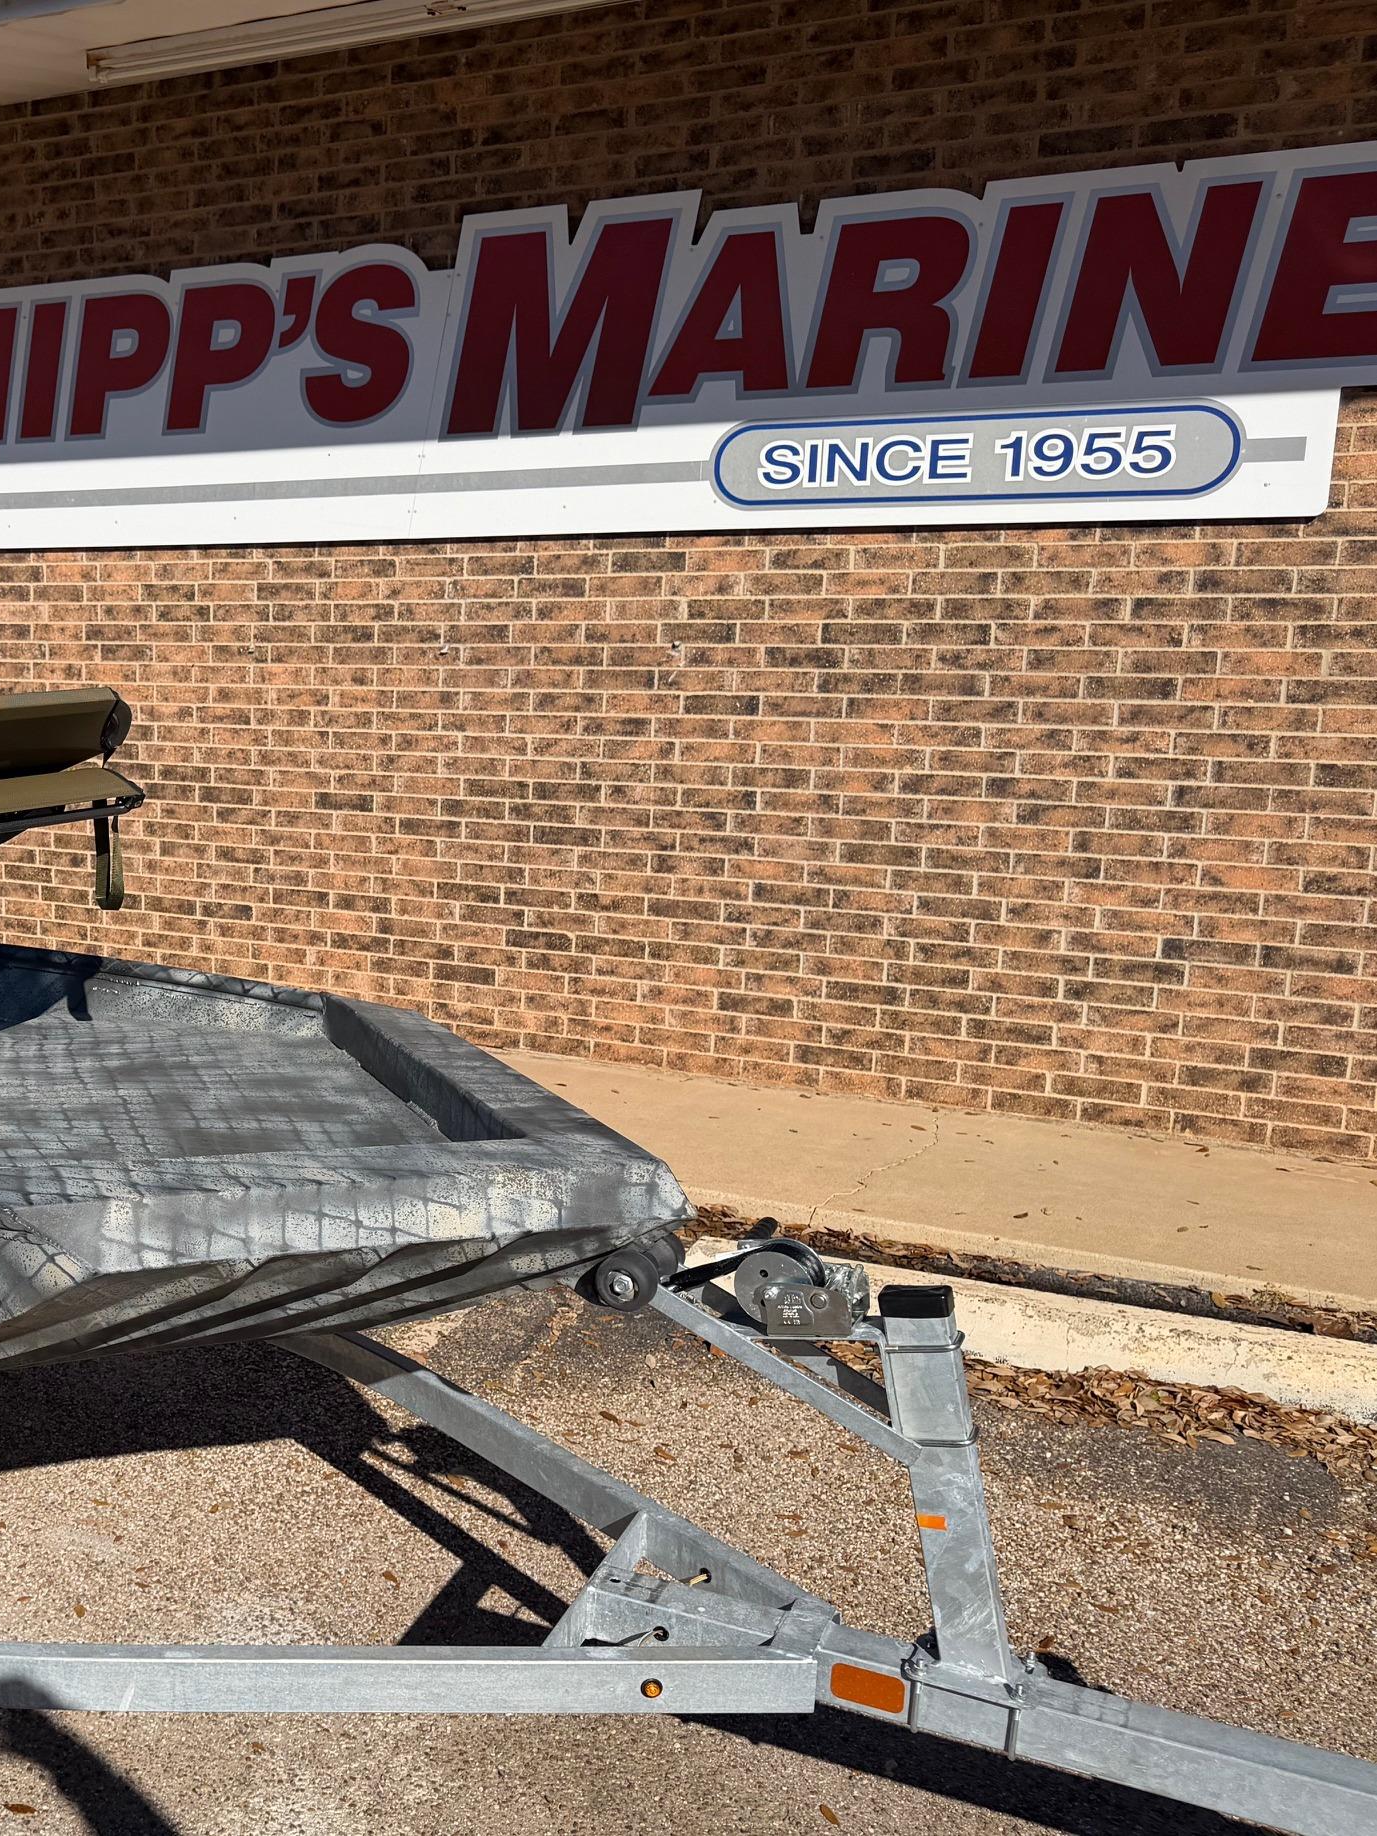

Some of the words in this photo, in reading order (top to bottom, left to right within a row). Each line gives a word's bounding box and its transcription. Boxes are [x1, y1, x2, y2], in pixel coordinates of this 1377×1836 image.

[445, 170, 1377, 437] MARINE
[760, 435, 973, 487] SINCE
[997, 426, 1175, 479] 1955
